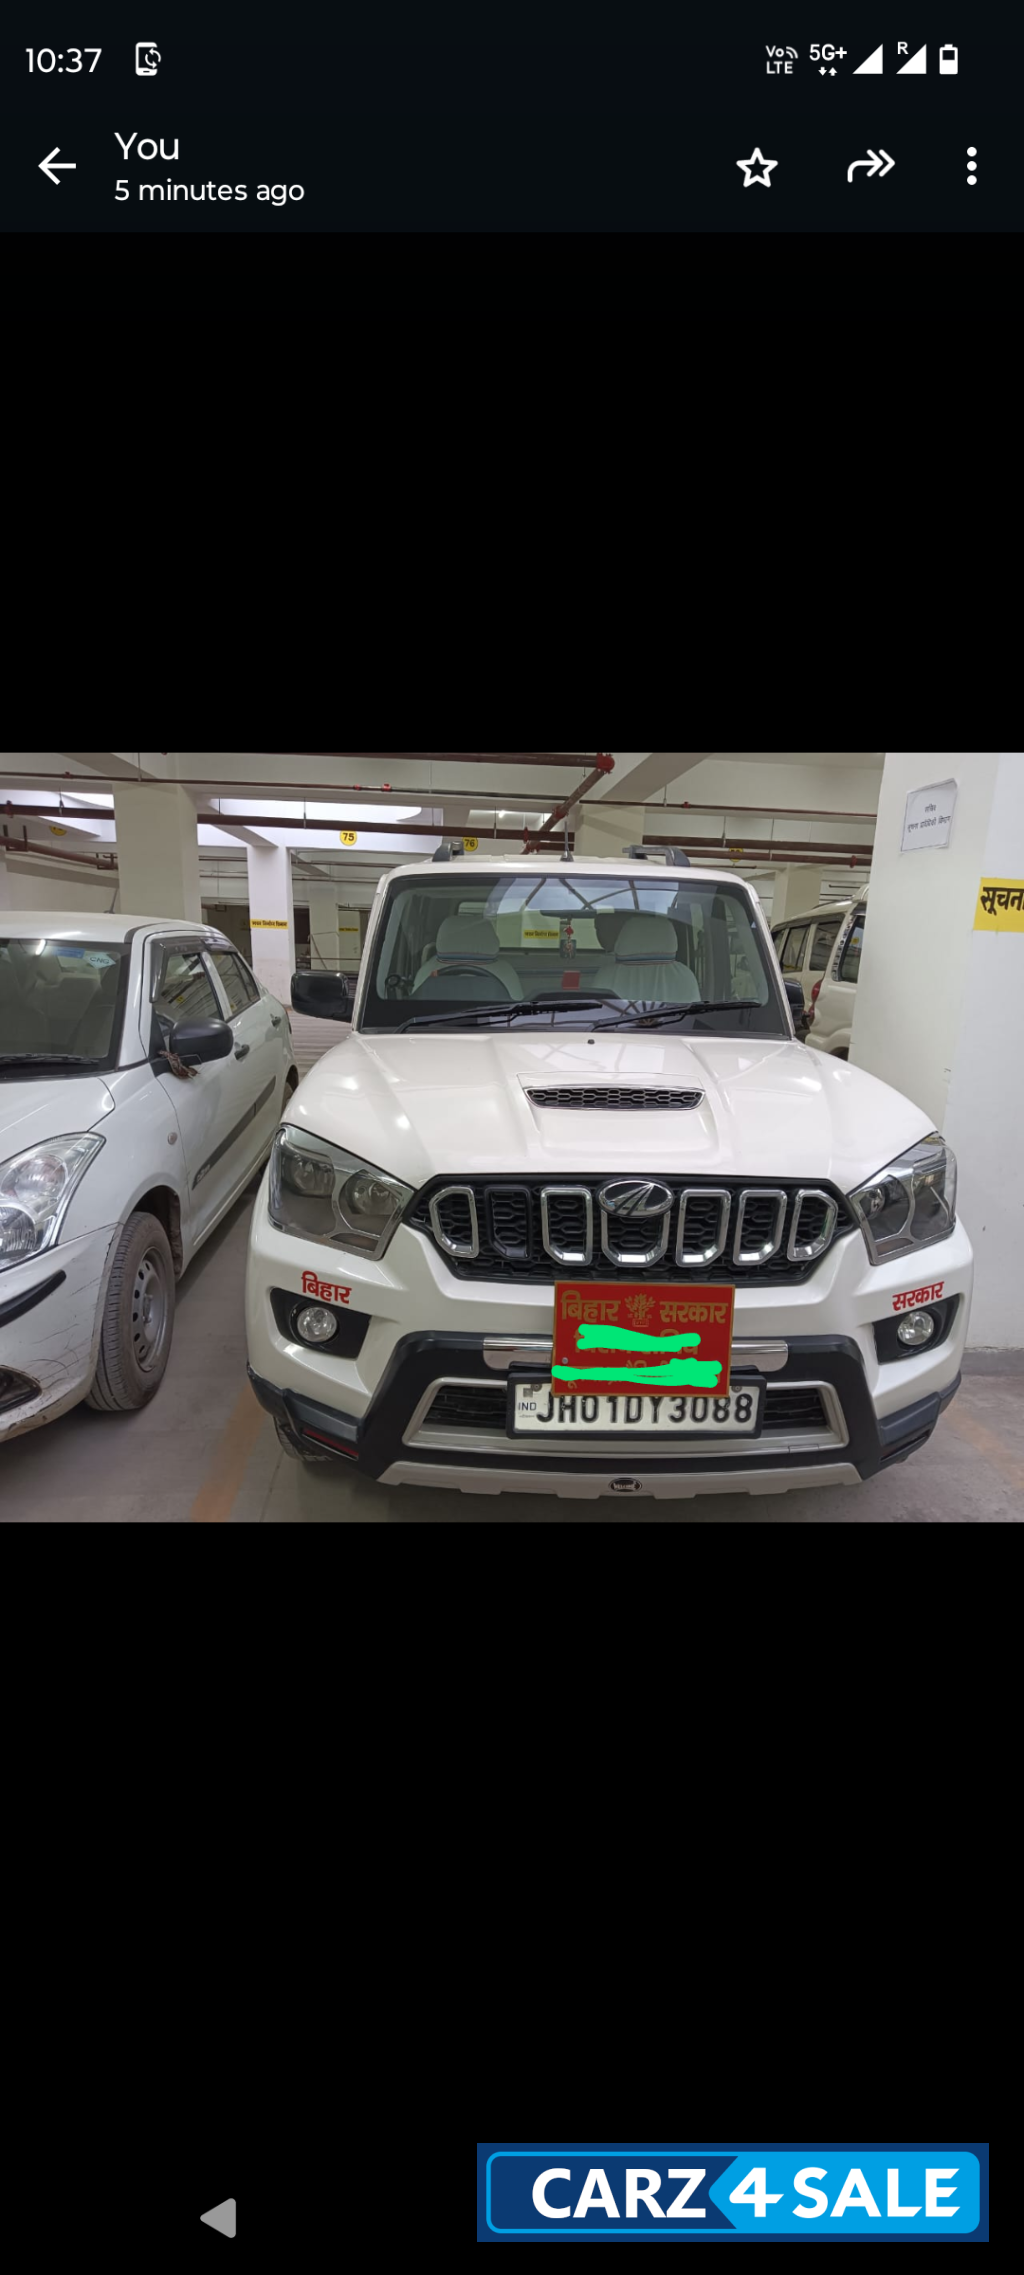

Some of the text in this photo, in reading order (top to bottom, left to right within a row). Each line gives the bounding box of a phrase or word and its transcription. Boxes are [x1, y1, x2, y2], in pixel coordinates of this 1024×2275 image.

[342, 832, 355, 842] 75
[465, 839, 475, 848] 76
[90, 956, 110, 965] CNG
[301, 1271, 351, 1304] बिहार
[892, 1281, 944, 1312] सरकार
[561, 1290, 729, 1324] बिहार सरकार
[518, 1402, 537, 1411] IND
[536, 1391, 753, 1424] JH01DY3088
